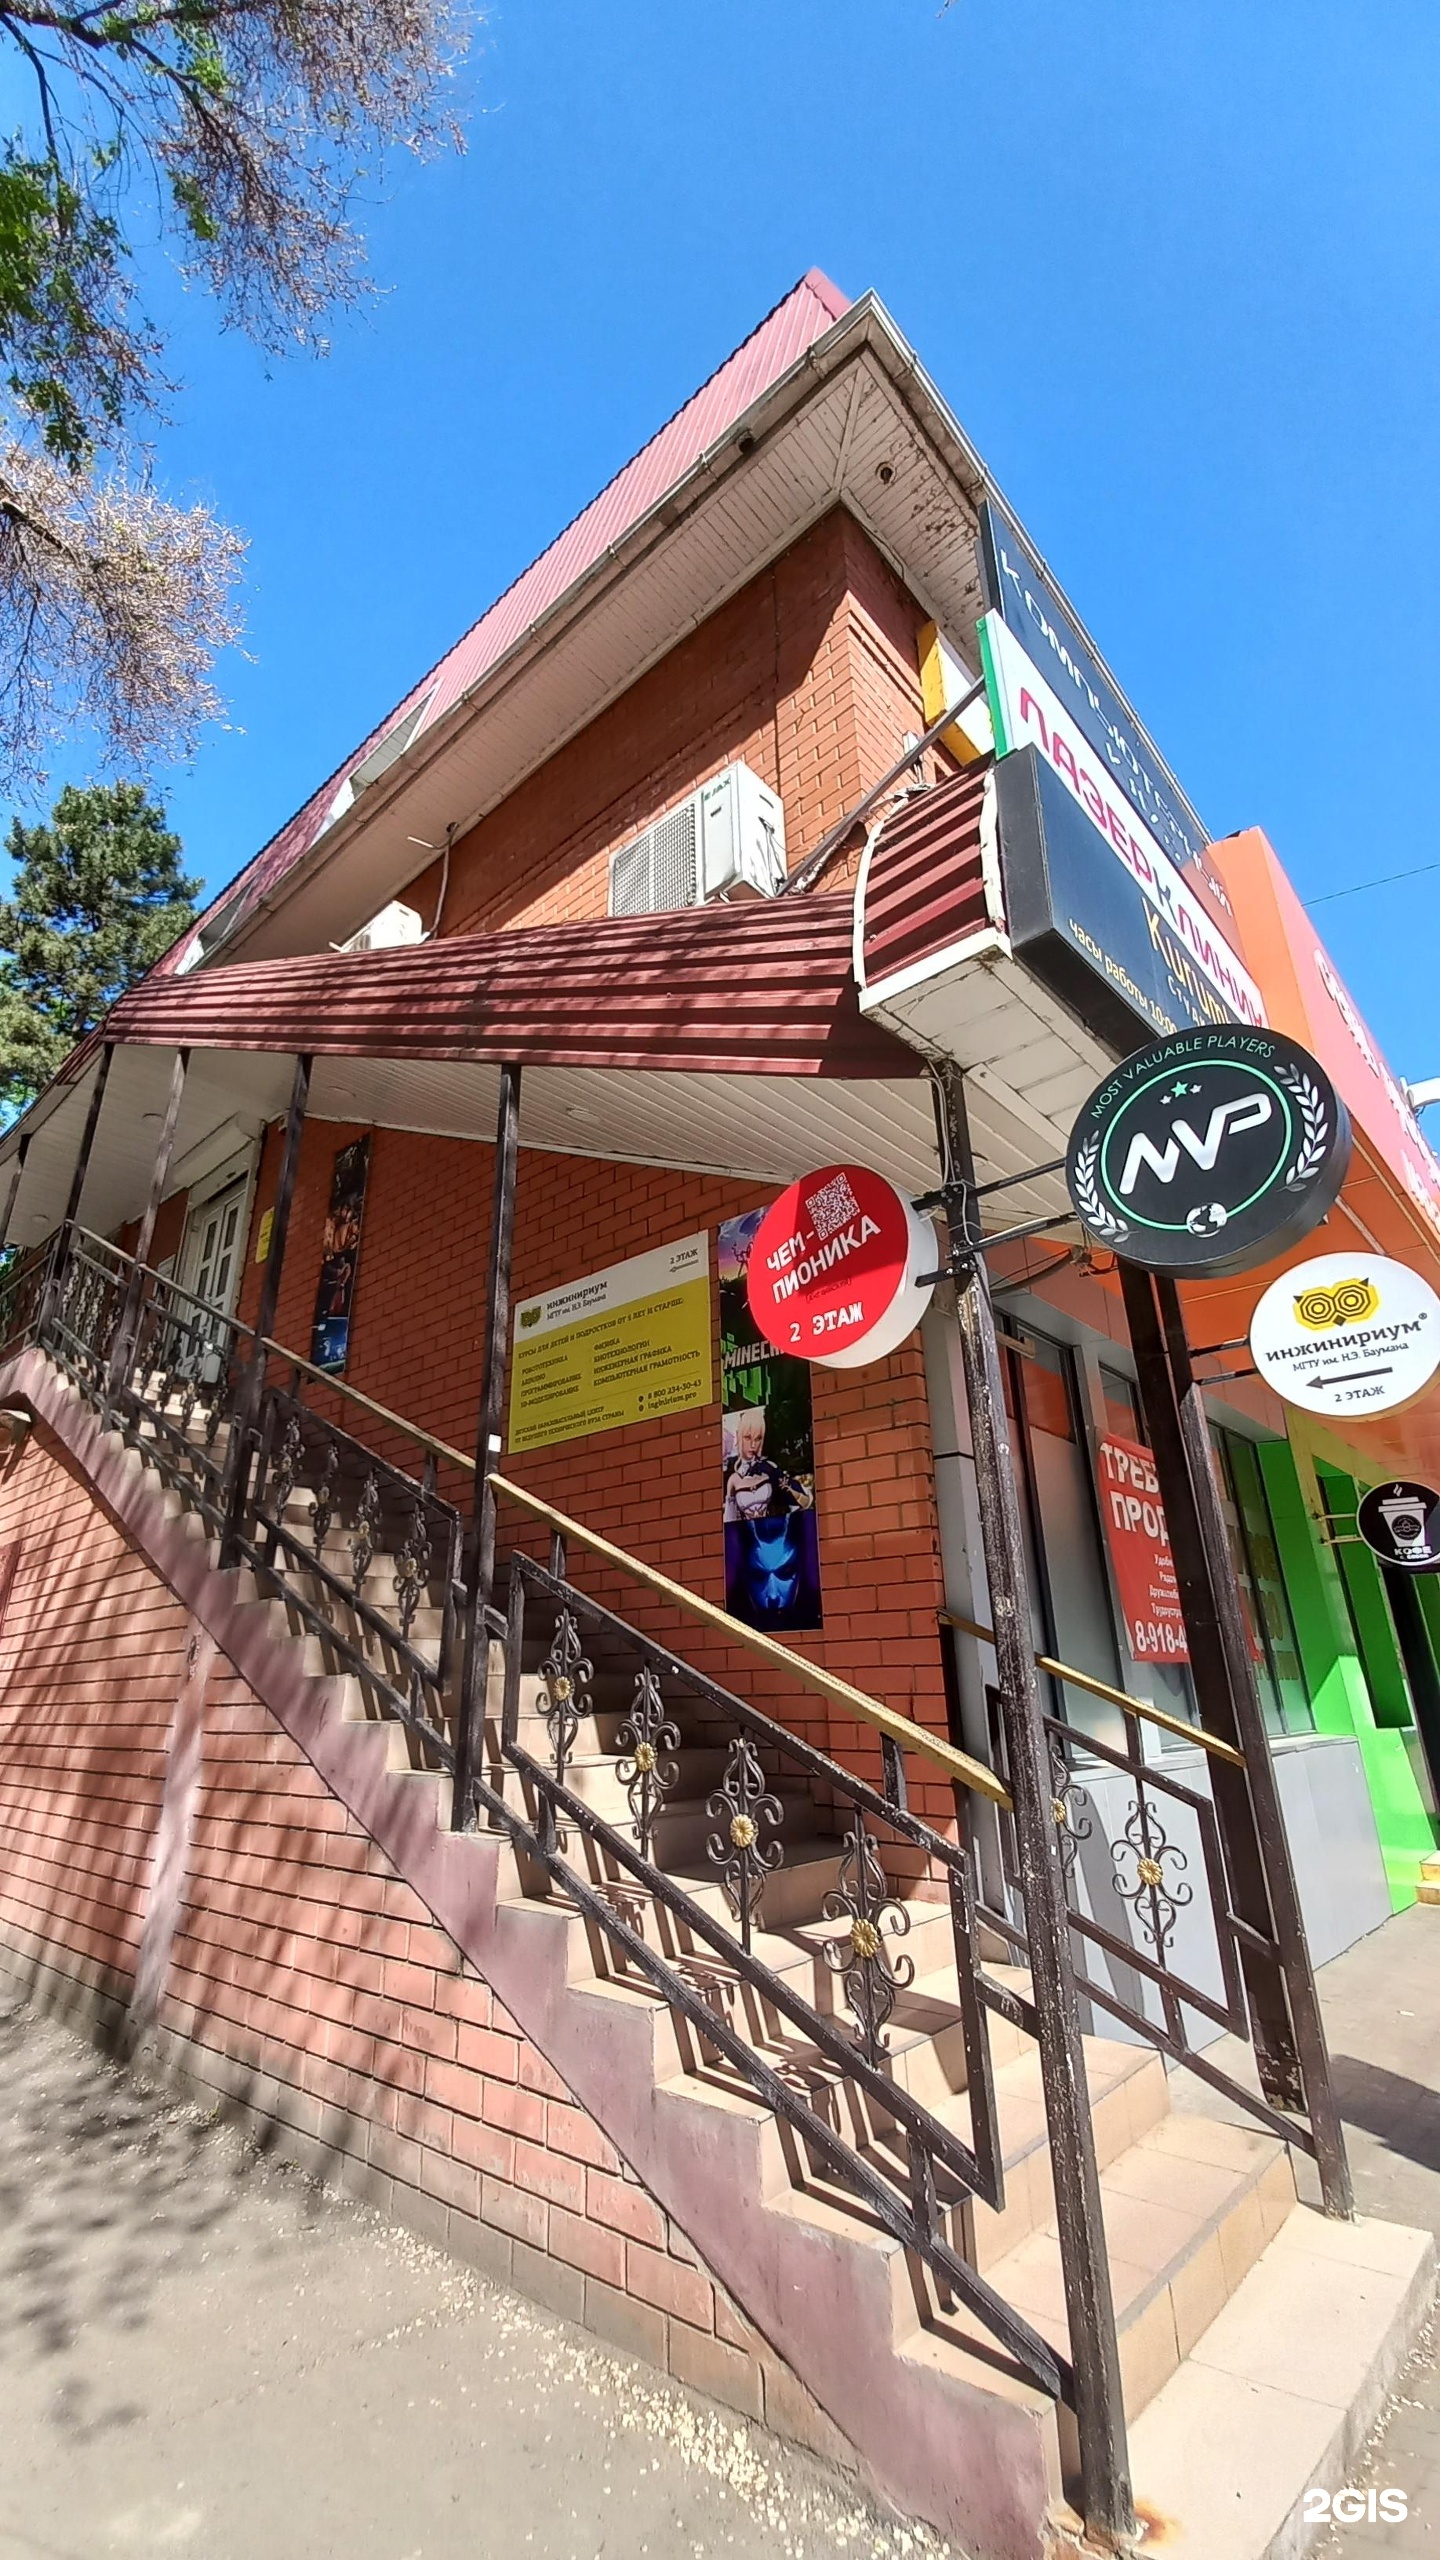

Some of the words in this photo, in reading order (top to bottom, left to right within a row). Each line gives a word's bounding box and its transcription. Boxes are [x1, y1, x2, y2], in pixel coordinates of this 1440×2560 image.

[1068, 918, 1102, 962] часы
[1104, 954, 1148, 1010] работы
[1090, 1079, 1124, 1119] MOST
[1122, 1036, 1203, 1080] VALUABLE
[1206, 1035, 1276, 1058] PLAYERS
[1119, 1093, 1272, 1195] MVP
[675, 1249, 697, 1262] ЭТАЖ
[766, 1231, 814, 1272] ЧЕМ-
[772, 1214, 882, 1304] ПИОНИКА
[546, 1282, 607, 1310] инжинириум
[617, 1316, 625, 1324] ОТ
[790, 1323, 800, 1342] 2
[812, 1301, 864, 1336] ЭТАЖ
[1265, 1320, 1422, 1362] инжинириум
[1292, 1358, 1320, 1372] МГТУ
[1322, 1357, 1340, 1366] им.
[1342, 1352, 1362, 1362] Н.Э.
[1363, 1342, 1409, 1358] Баумана
[1334, 1394, 1342, 1402] 2
[1346, 1386, 1386, 1400] ЭТАЖ
[1100, 1442, 1159, 1494] ТРЕБ
[1394, 1546, 1432, 1556] КОФЕ
